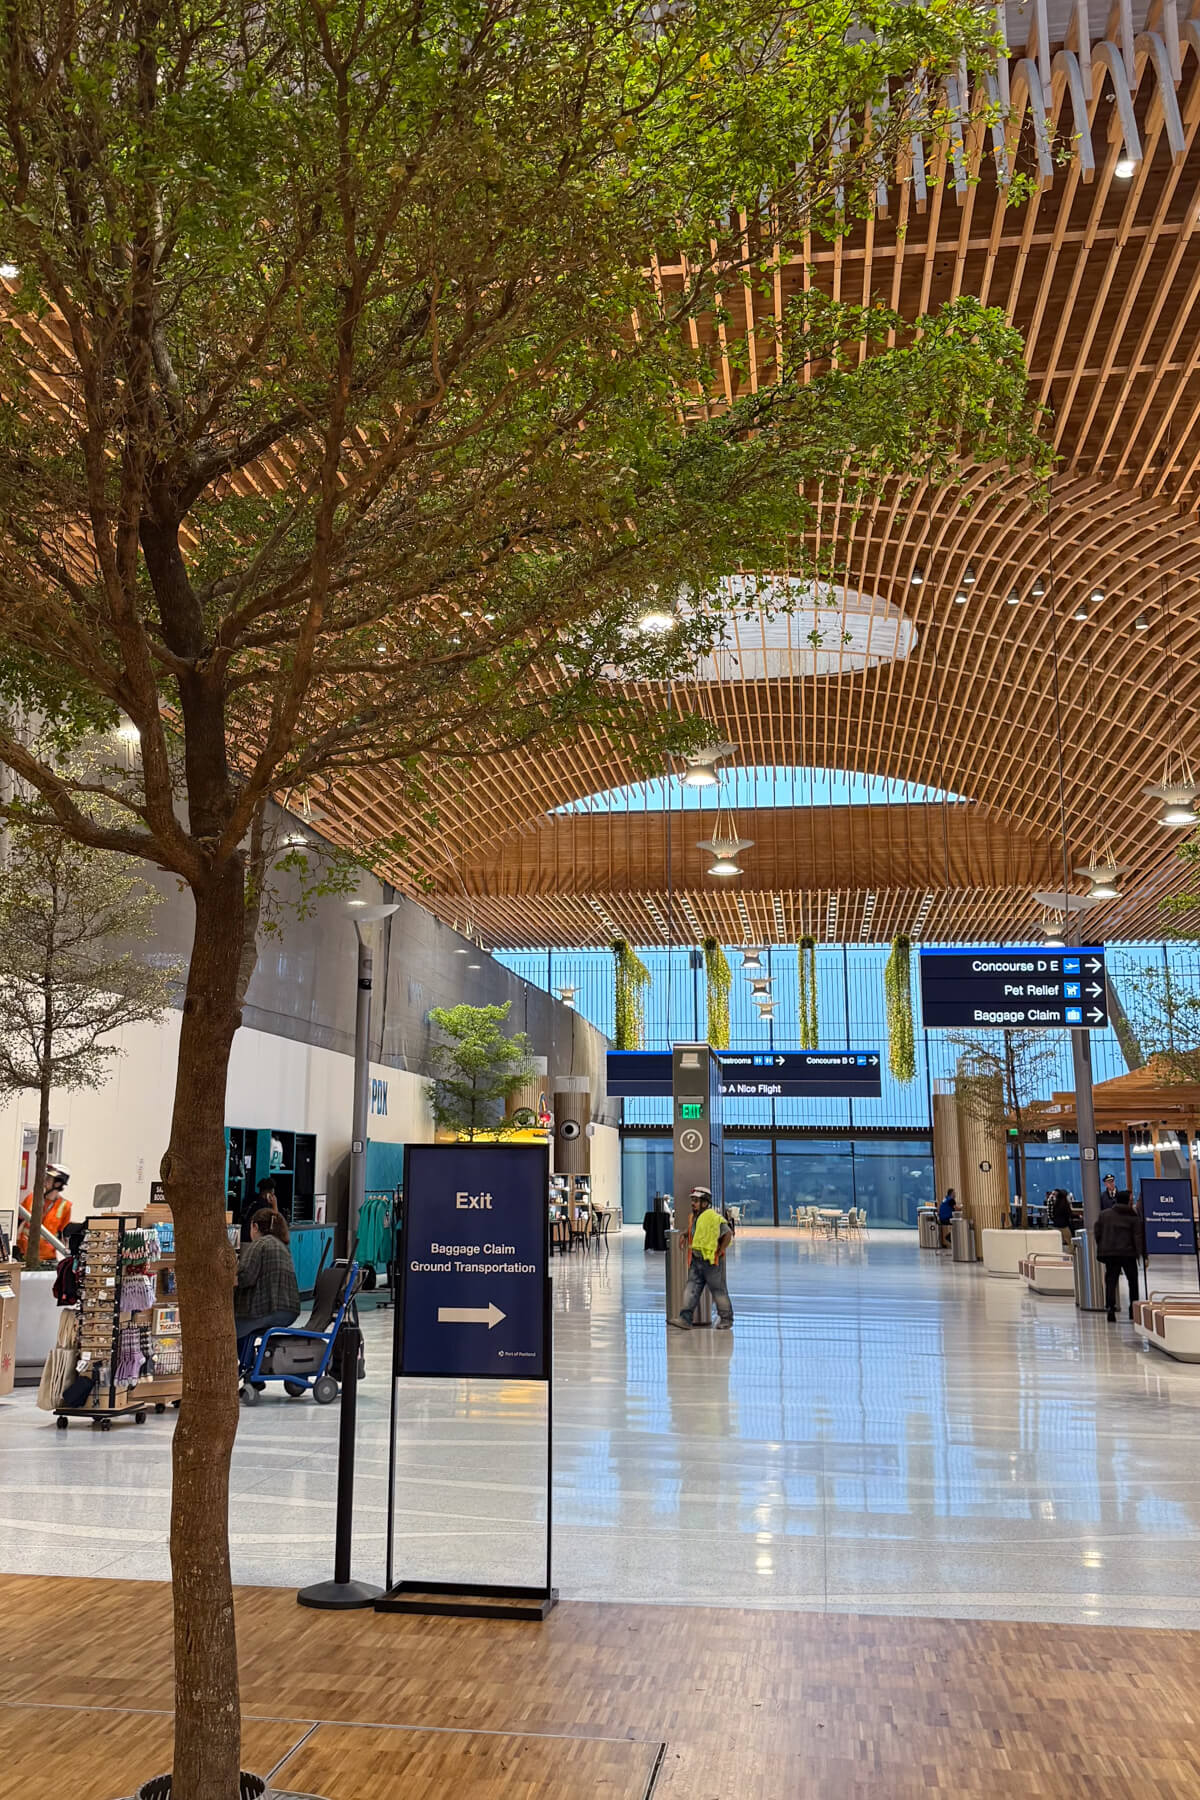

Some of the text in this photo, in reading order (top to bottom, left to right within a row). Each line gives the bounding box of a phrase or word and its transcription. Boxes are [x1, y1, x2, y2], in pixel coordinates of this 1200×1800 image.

[972, 960, 1059, 972] Concourse D E
[1004, 984, 1060, 996] Pet Relief
[974, 1009, 1060, 1022] Baggage Claim
[806, 1056, 841, 1065] Concourse
[728, 1084, 736, 1093] A
[737, 1084, 757, 1093] Nice
[758, 1084, 782, 1095] Flight
[371, 1078, 388, 1116] PDX
[682, 1103, 701, 1119] EXIT
[455, 1191, 493, 1209] Exit
[1159, 1195, 1174, 1203] Exit
[430, 1243, 516, 1256] Baggage Claim
[410, 1260, 537, 1275] Ground Transportation
